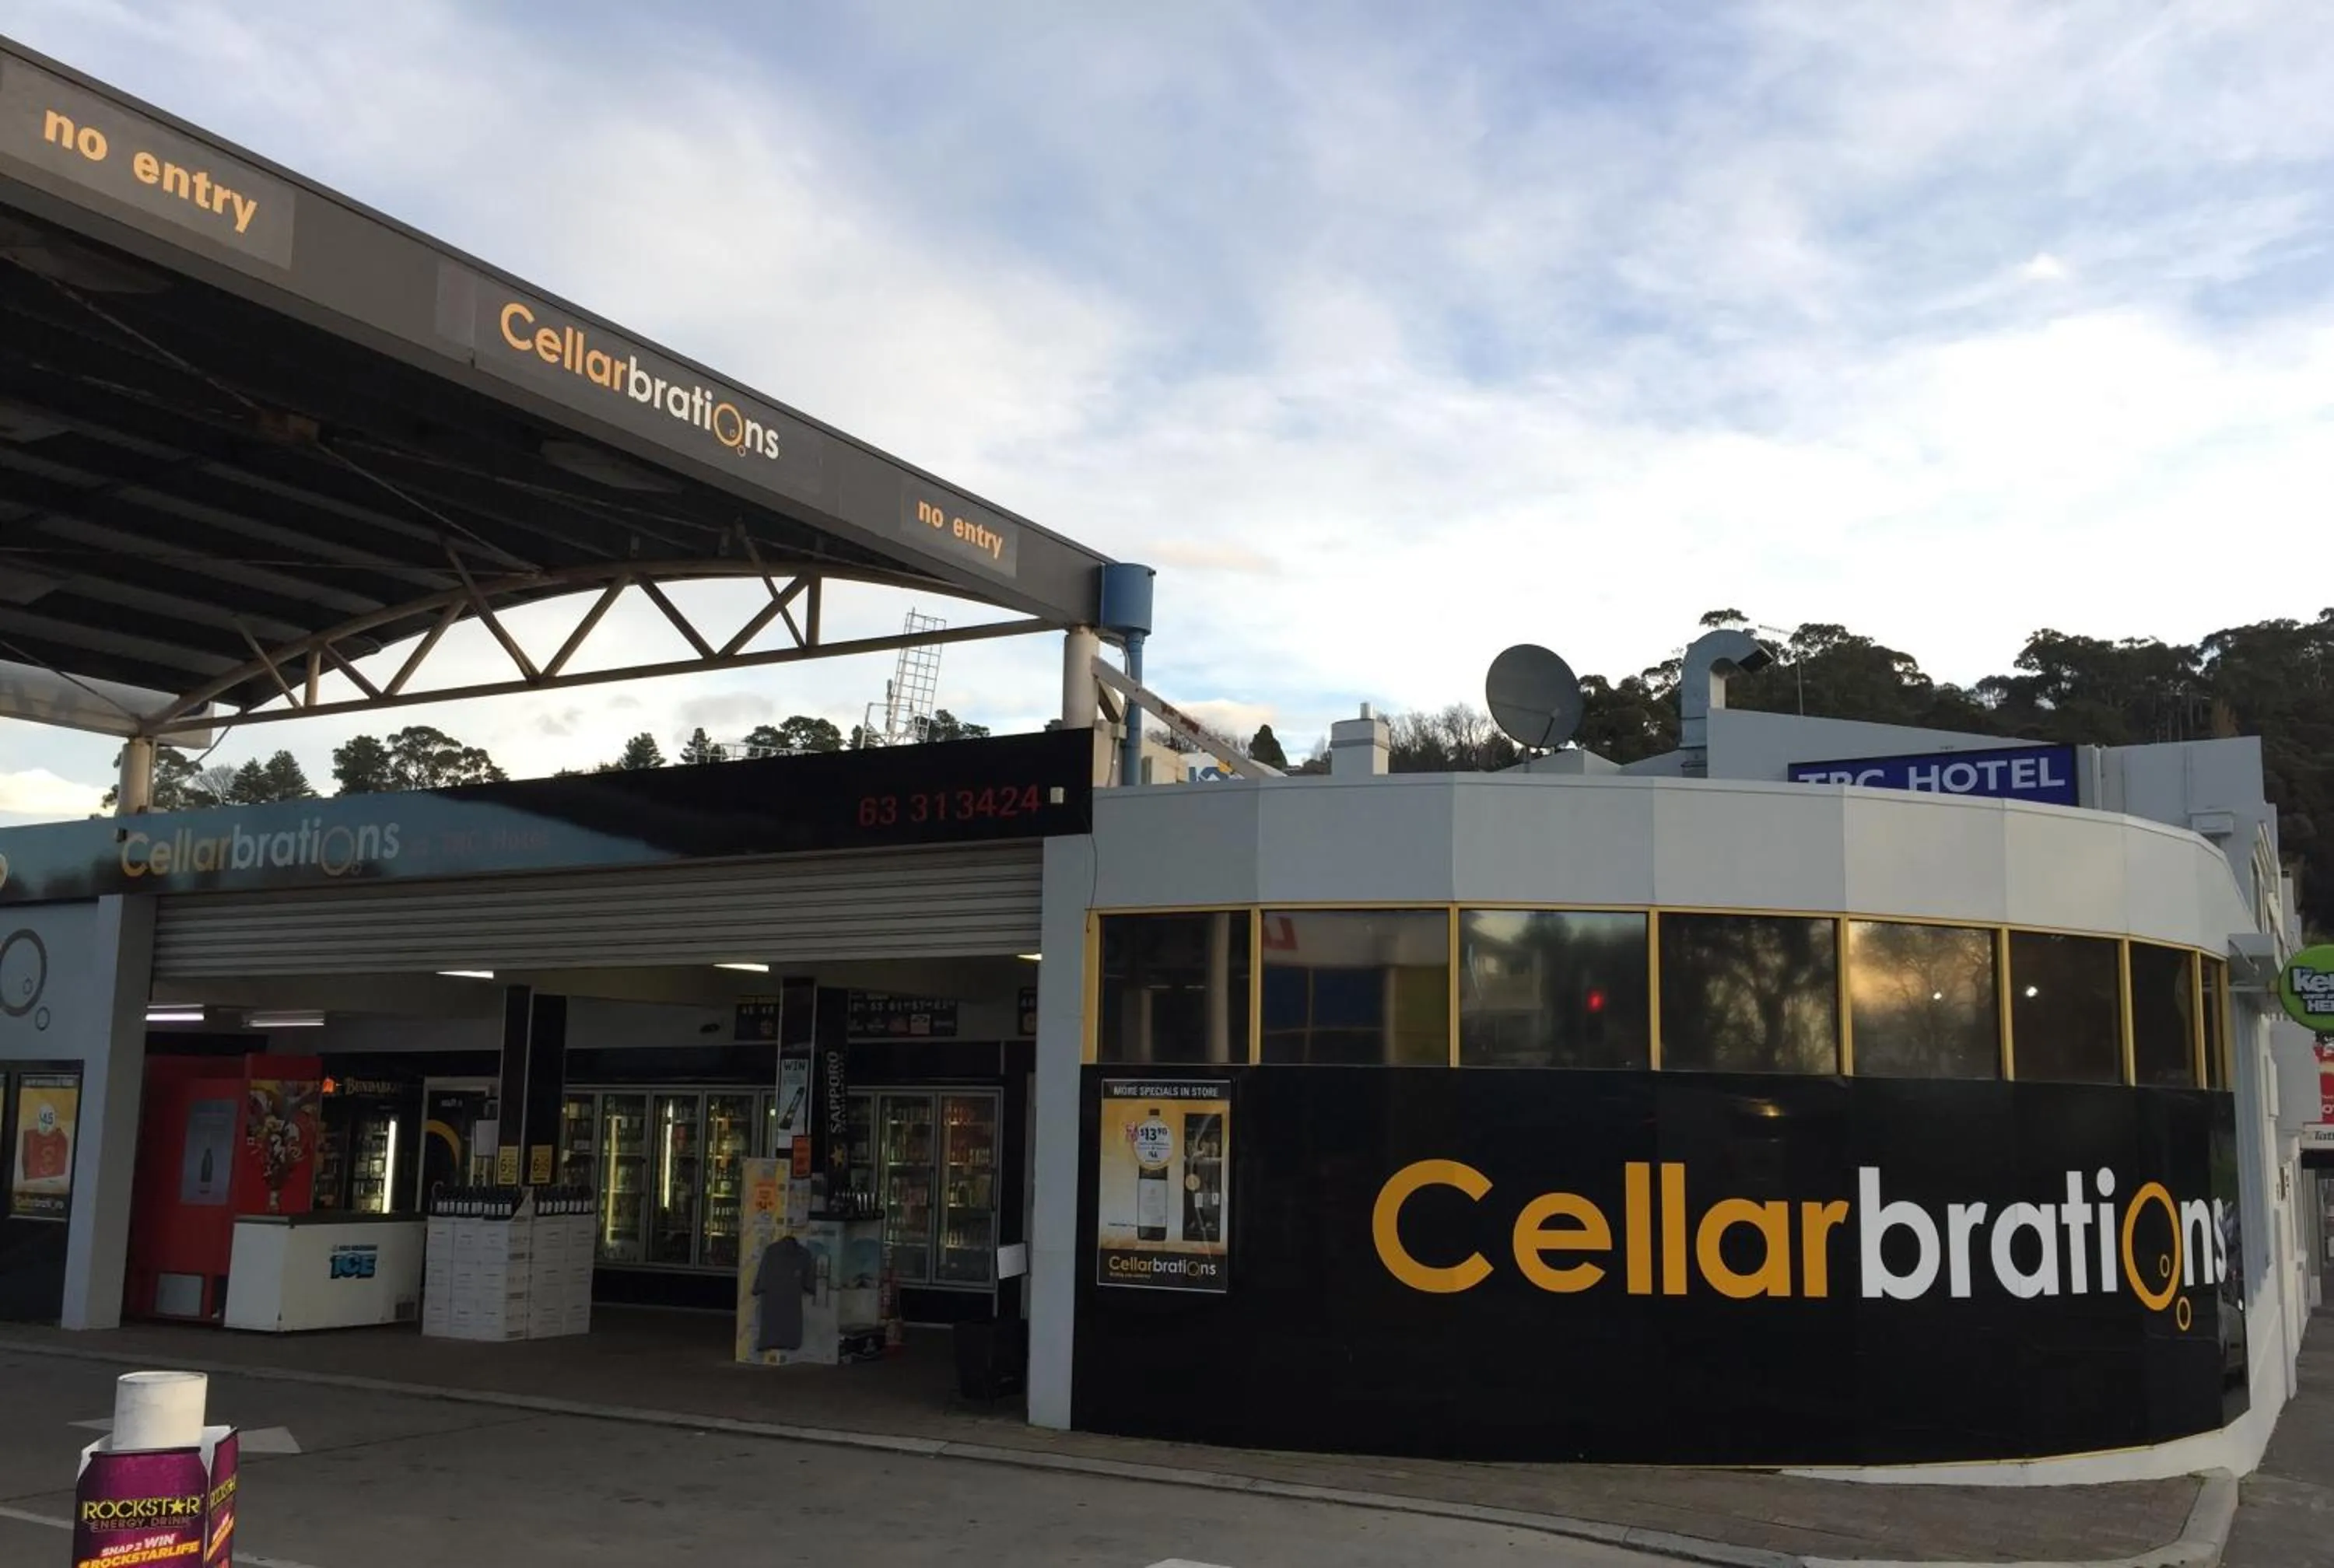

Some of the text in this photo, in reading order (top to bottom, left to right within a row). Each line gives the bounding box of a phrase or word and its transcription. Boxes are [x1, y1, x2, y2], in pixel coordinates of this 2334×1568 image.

[44, 109, 258, 235] no entry
[500, 303, 779, 459] Cellarbrations
[917, 499, 1002, 560] no entry
[1908, 757, 2066, 793] HOTEL
[859, 784, 1042, 827] 63 313424
[122, 818, 400, 877] Cellarbrations
[783, 1060, 806, 1071] WIN
[826, 1051, 842, 1133] SAPPORO
[1114, 1085, 1219, 1097] MORE SPECIALS IN STORE
[1372, 1158, 2227, 1311] Cellarbrations
[330, 1254, 377, 1279] ICE
[1108, 1255, 1217, 1277] Cellarbrations
[92, 1517, 191, 1531] ENERGY DRINK
[144, 1533, 177, 1548] WIN
